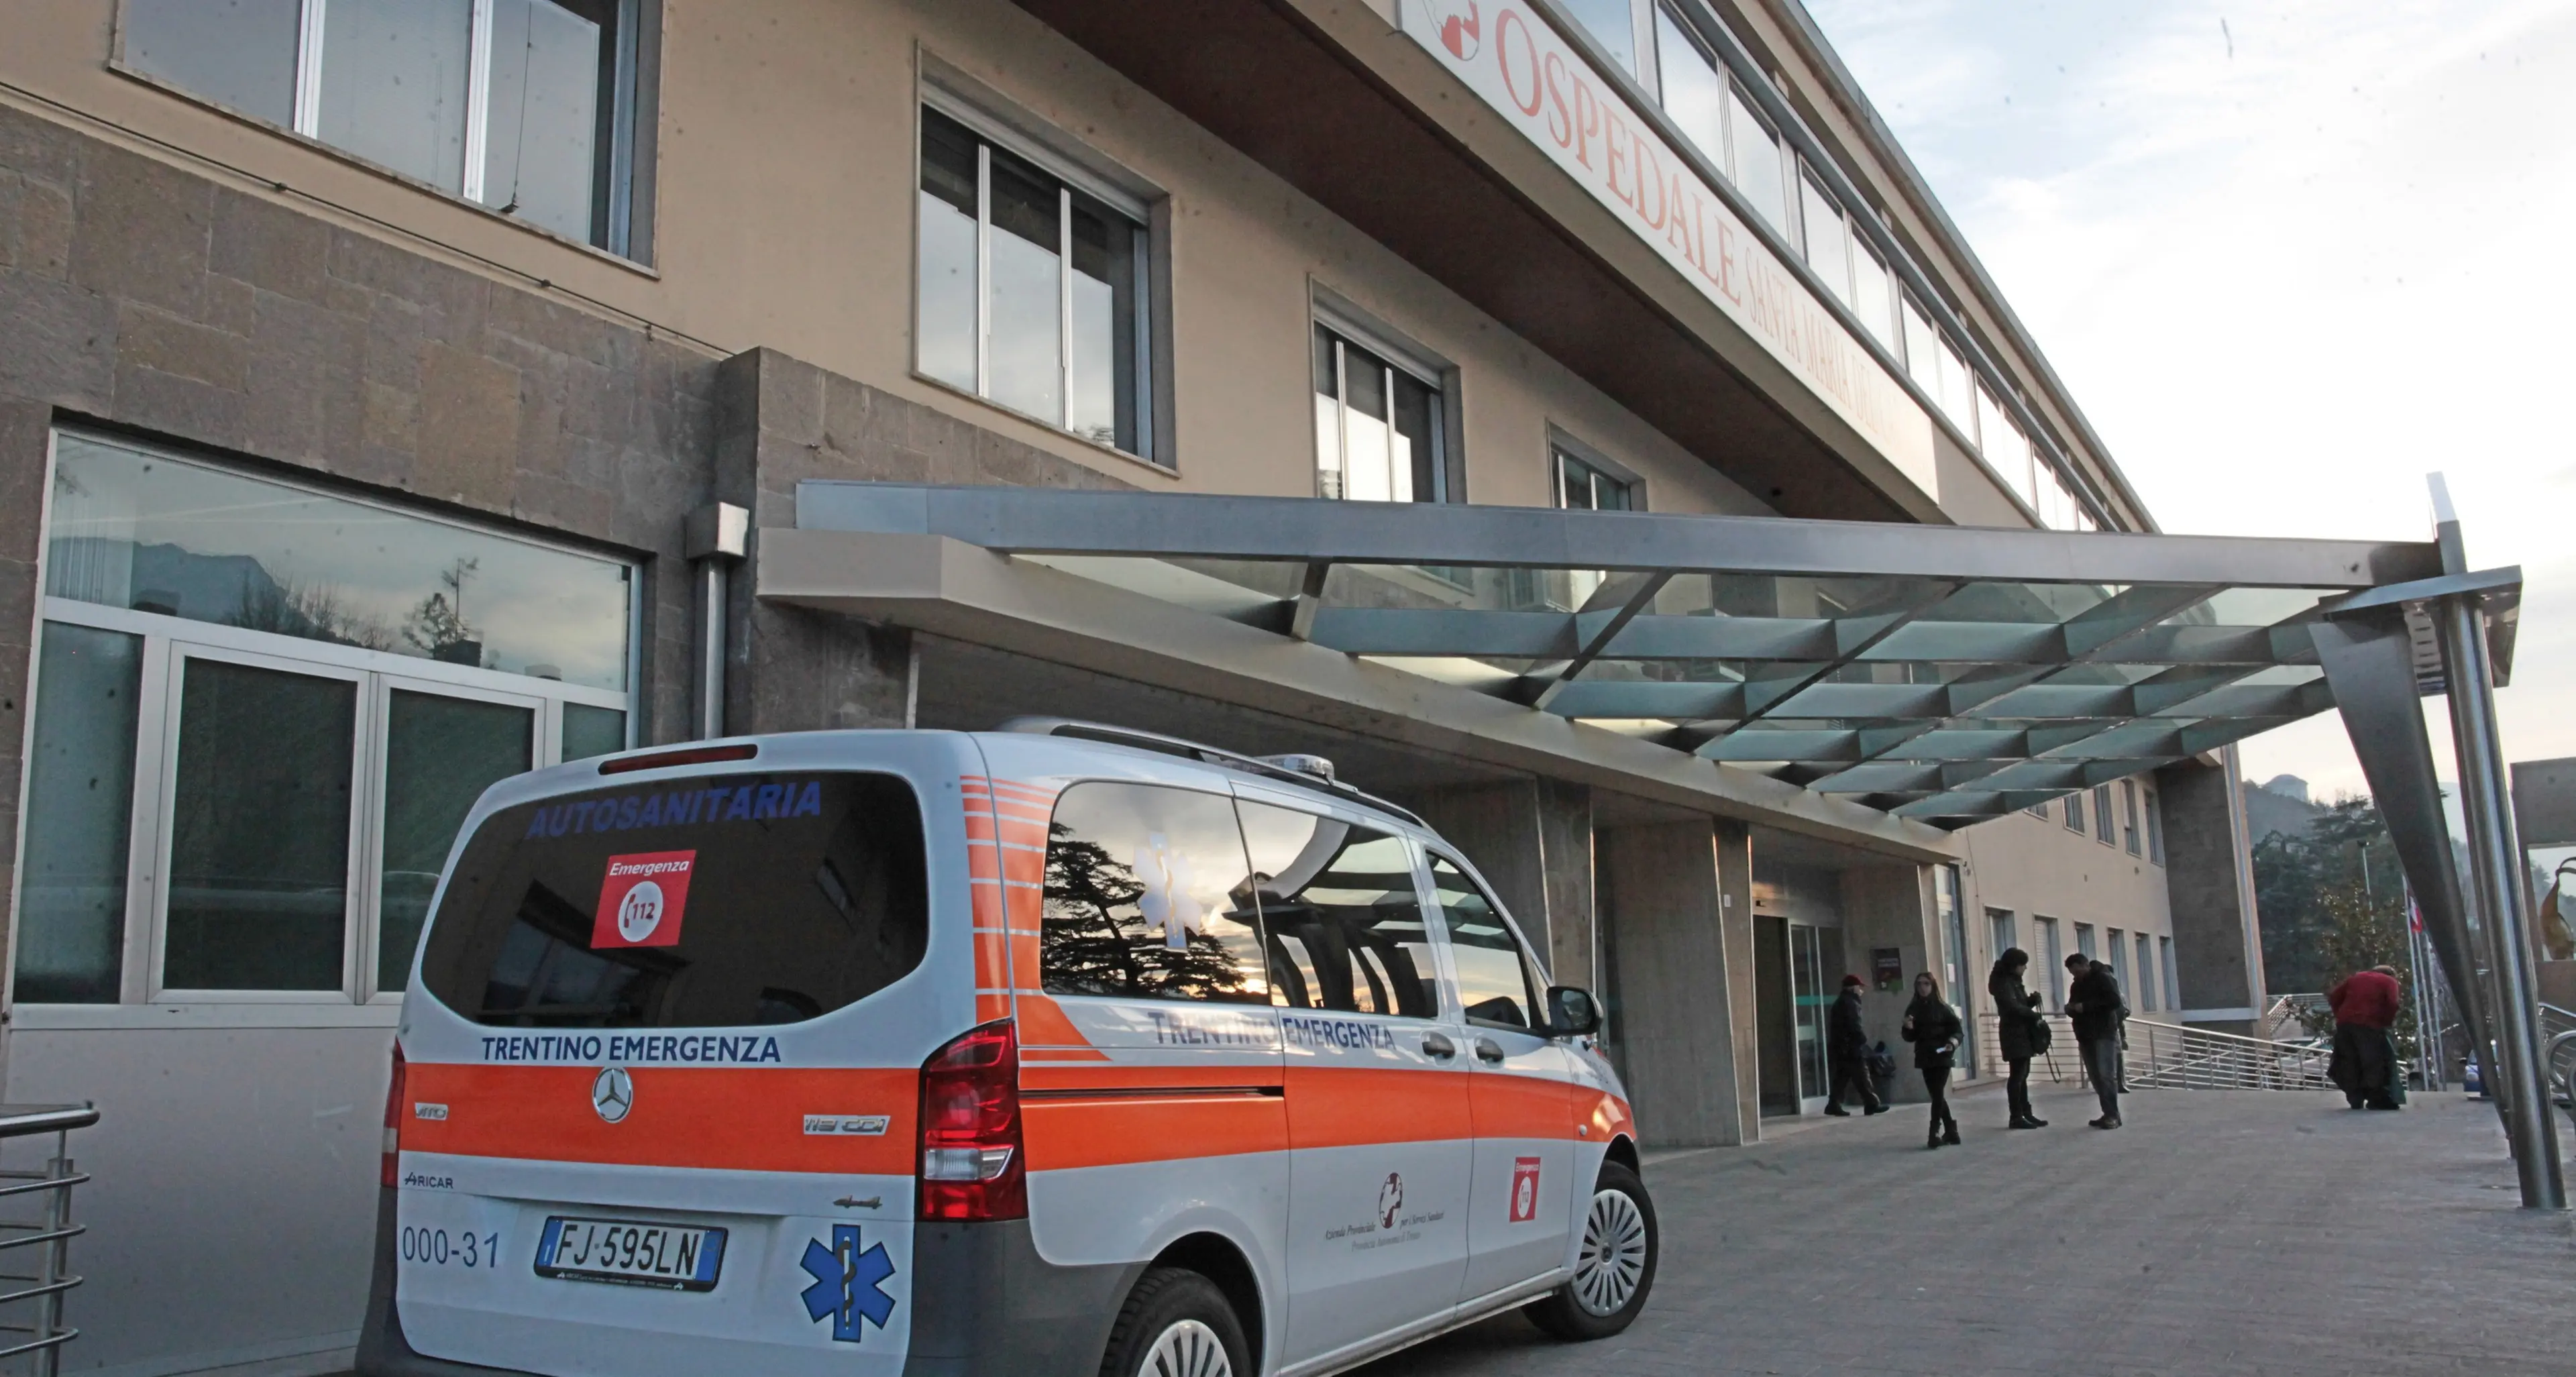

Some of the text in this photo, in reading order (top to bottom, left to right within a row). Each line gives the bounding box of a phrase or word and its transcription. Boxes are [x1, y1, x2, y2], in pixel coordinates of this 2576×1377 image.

[1495, 8, 1741, 307] OSPEDALE
[1746, 246, 1801, 364] SANTA
[1803, 302, 1853, 410] MARIA
[526, 781, 821, 838] AUTOSANITARIA
[609, 861, 690, 877] Emergenza
[632, 902, 655, 921] 112
[1148, 1011, 1397, 1051] TRENTINO EMERGENZA
[482, 1036, 781, 1063] TRENTINO EMERGENZA
[841, 1119, 885, 1133] CDI
[405, 1172, 453, 1189] ARICAR
[403, 1226, 498, 1268] 000-31
